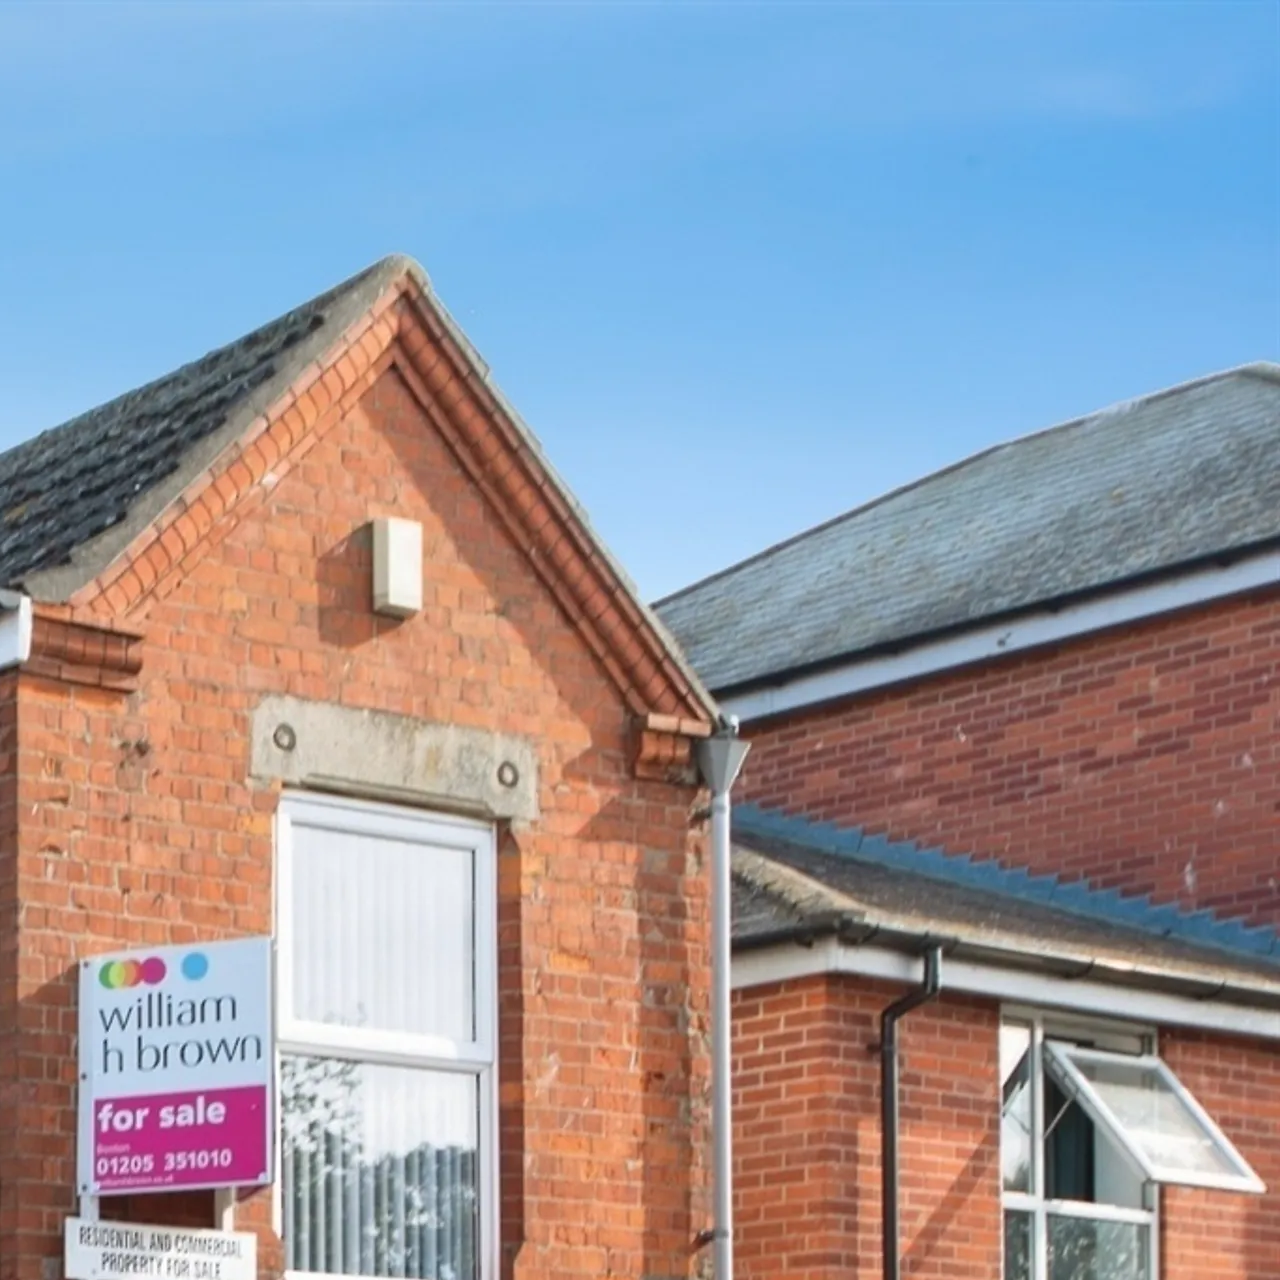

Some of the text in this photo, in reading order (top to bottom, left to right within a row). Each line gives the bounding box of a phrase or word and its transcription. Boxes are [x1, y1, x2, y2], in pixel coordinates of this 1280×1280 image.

[98, 992, 237, 1033] william
[102, 1034, 262, 1074] h brown
[97, 1095, 226, 1133] for sale
[96, 1149, 233, 1176] 01205 351010
[79, 1226, 243, 1259] RESIDENTIAL AND COMMERCIAL
[101, 1253, 221, 1280] PROPERTY FOR SALE
